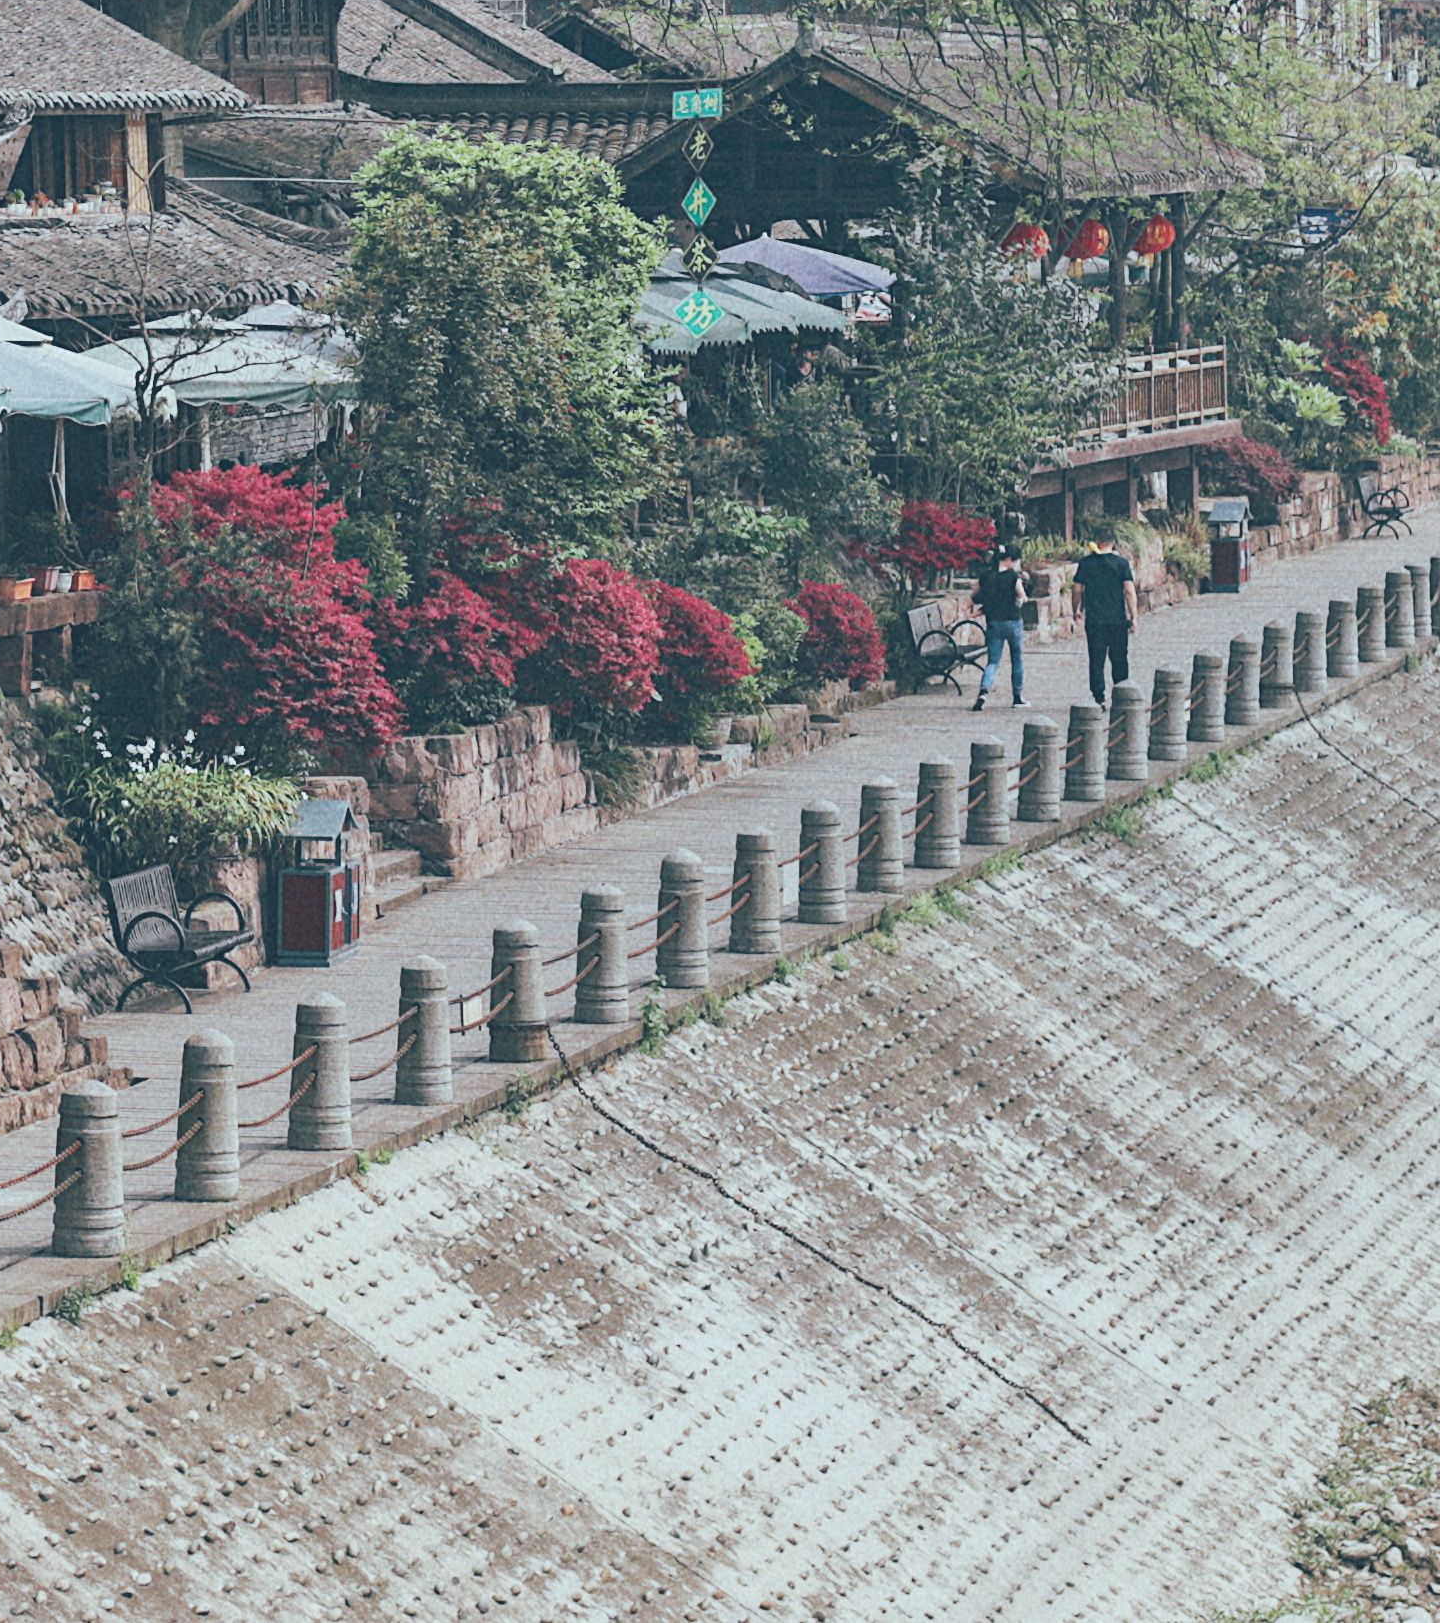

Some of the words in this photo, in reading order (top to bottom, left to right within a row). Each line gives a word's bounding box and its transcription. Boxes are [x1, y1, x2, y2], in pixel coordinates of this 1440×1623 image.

[676, 94, 718, 114] 皂角树
[683, 130, 715, 327] 老井茶坊
